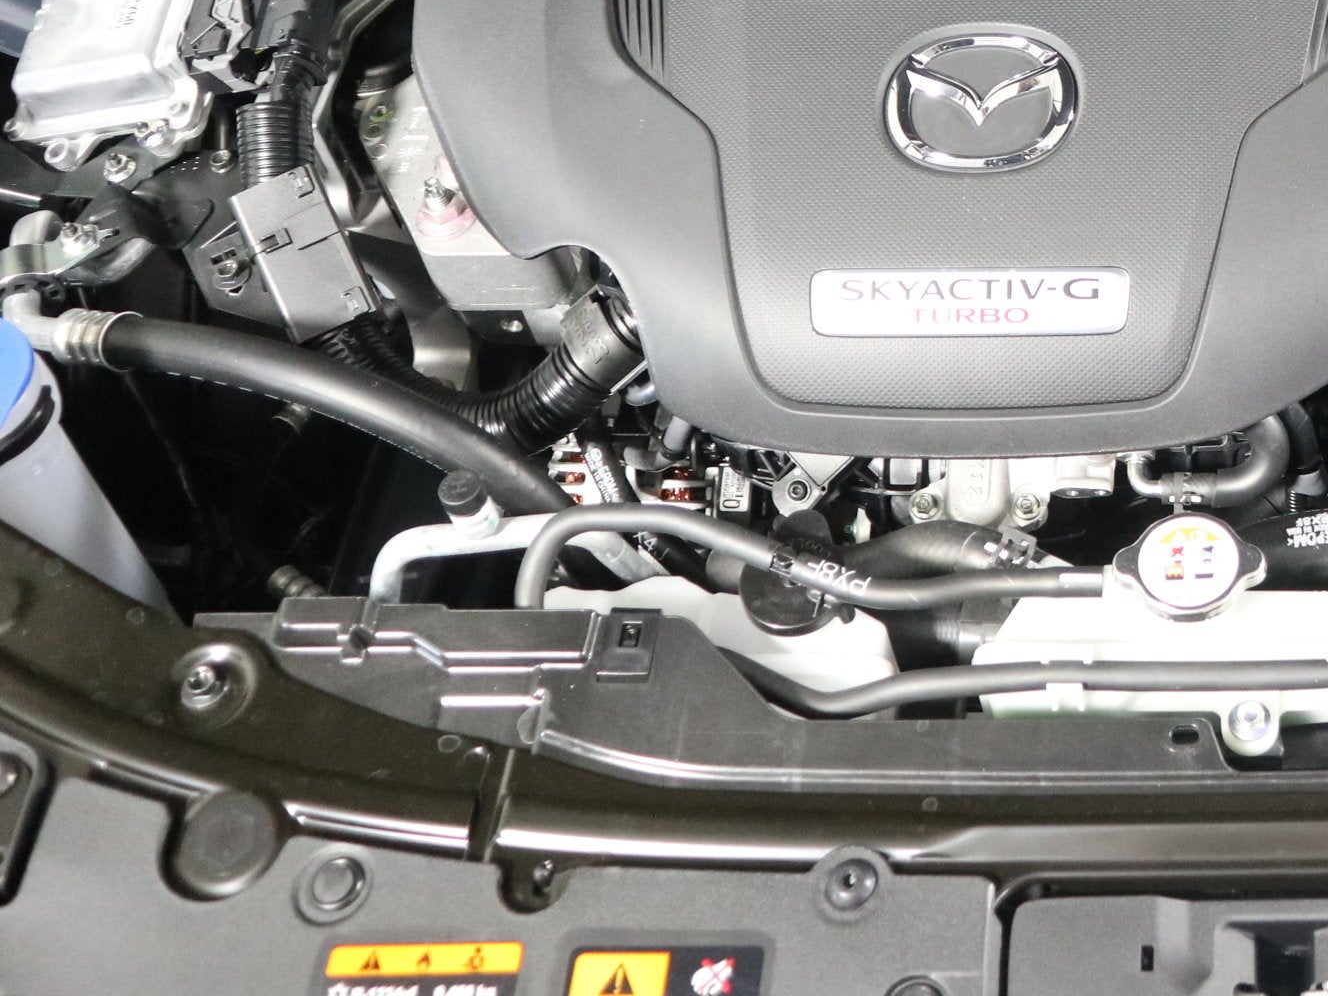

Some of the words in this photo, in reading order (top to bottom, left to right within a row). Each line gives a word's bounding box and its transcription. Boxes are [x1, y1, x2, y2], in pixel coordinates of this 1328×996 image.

[840, 277, 1100, 302] SKYACTIV-G
[911, 307, 1030, 324] TURBO
[806, 558, 872, 597] PX8F
